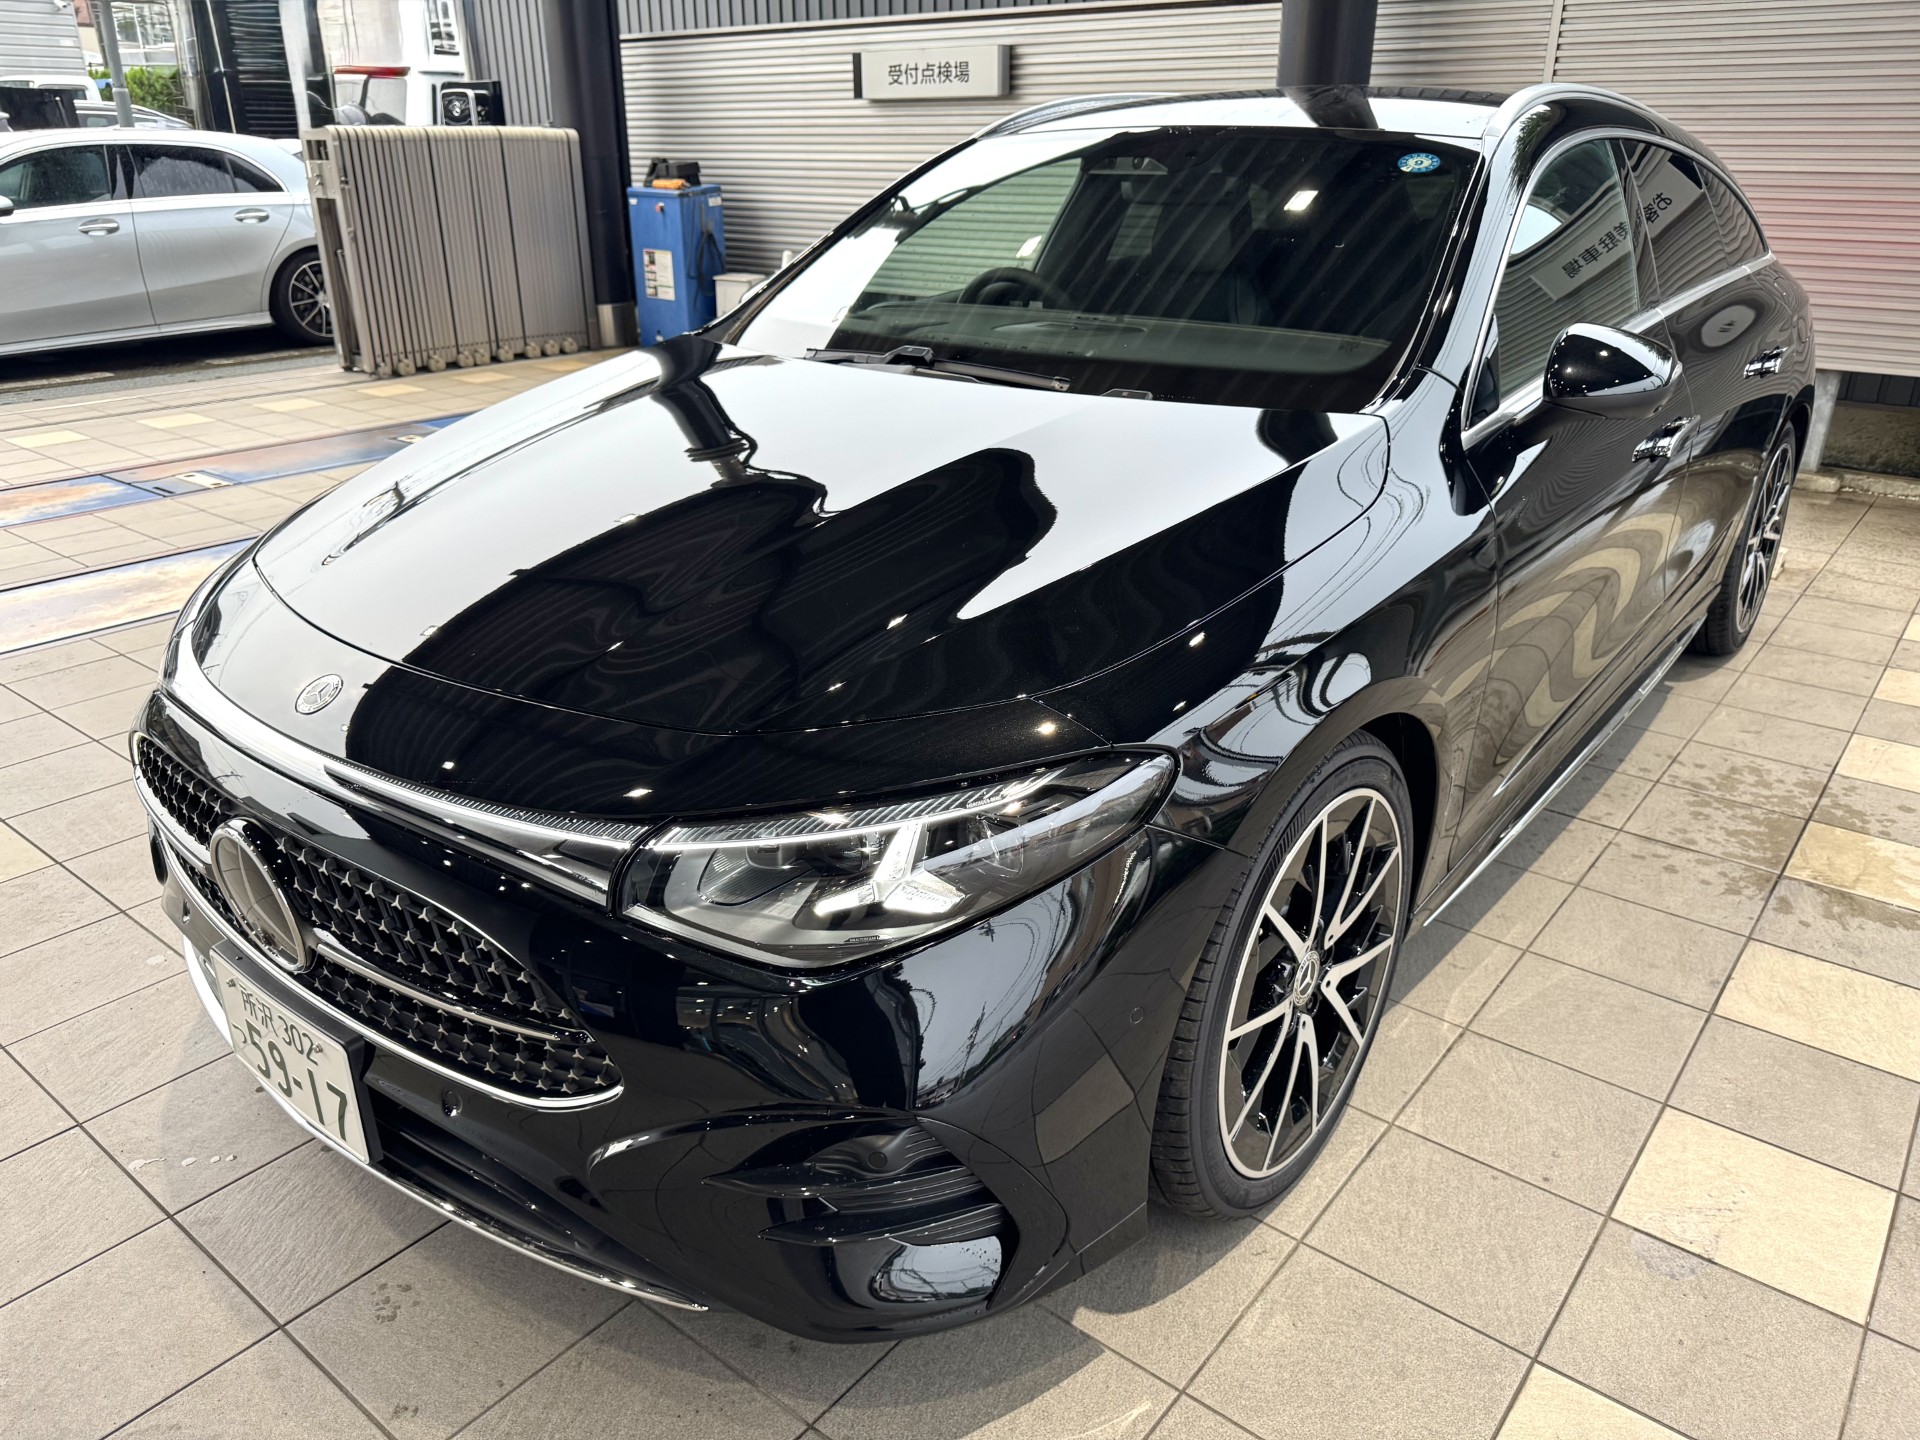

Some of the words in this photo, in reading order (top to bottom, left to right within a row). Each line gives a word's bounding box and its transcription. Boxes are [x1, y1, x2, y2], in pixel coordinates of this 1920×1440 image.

[888, 60, 970, 85] 受付点検場
[239, 981, 278, 1037] 所沢
[278, 1015, 319, 1066] 302
[231, 1022, 247, 1044] つ
[245, 1019, 347, 1142] 59-17
